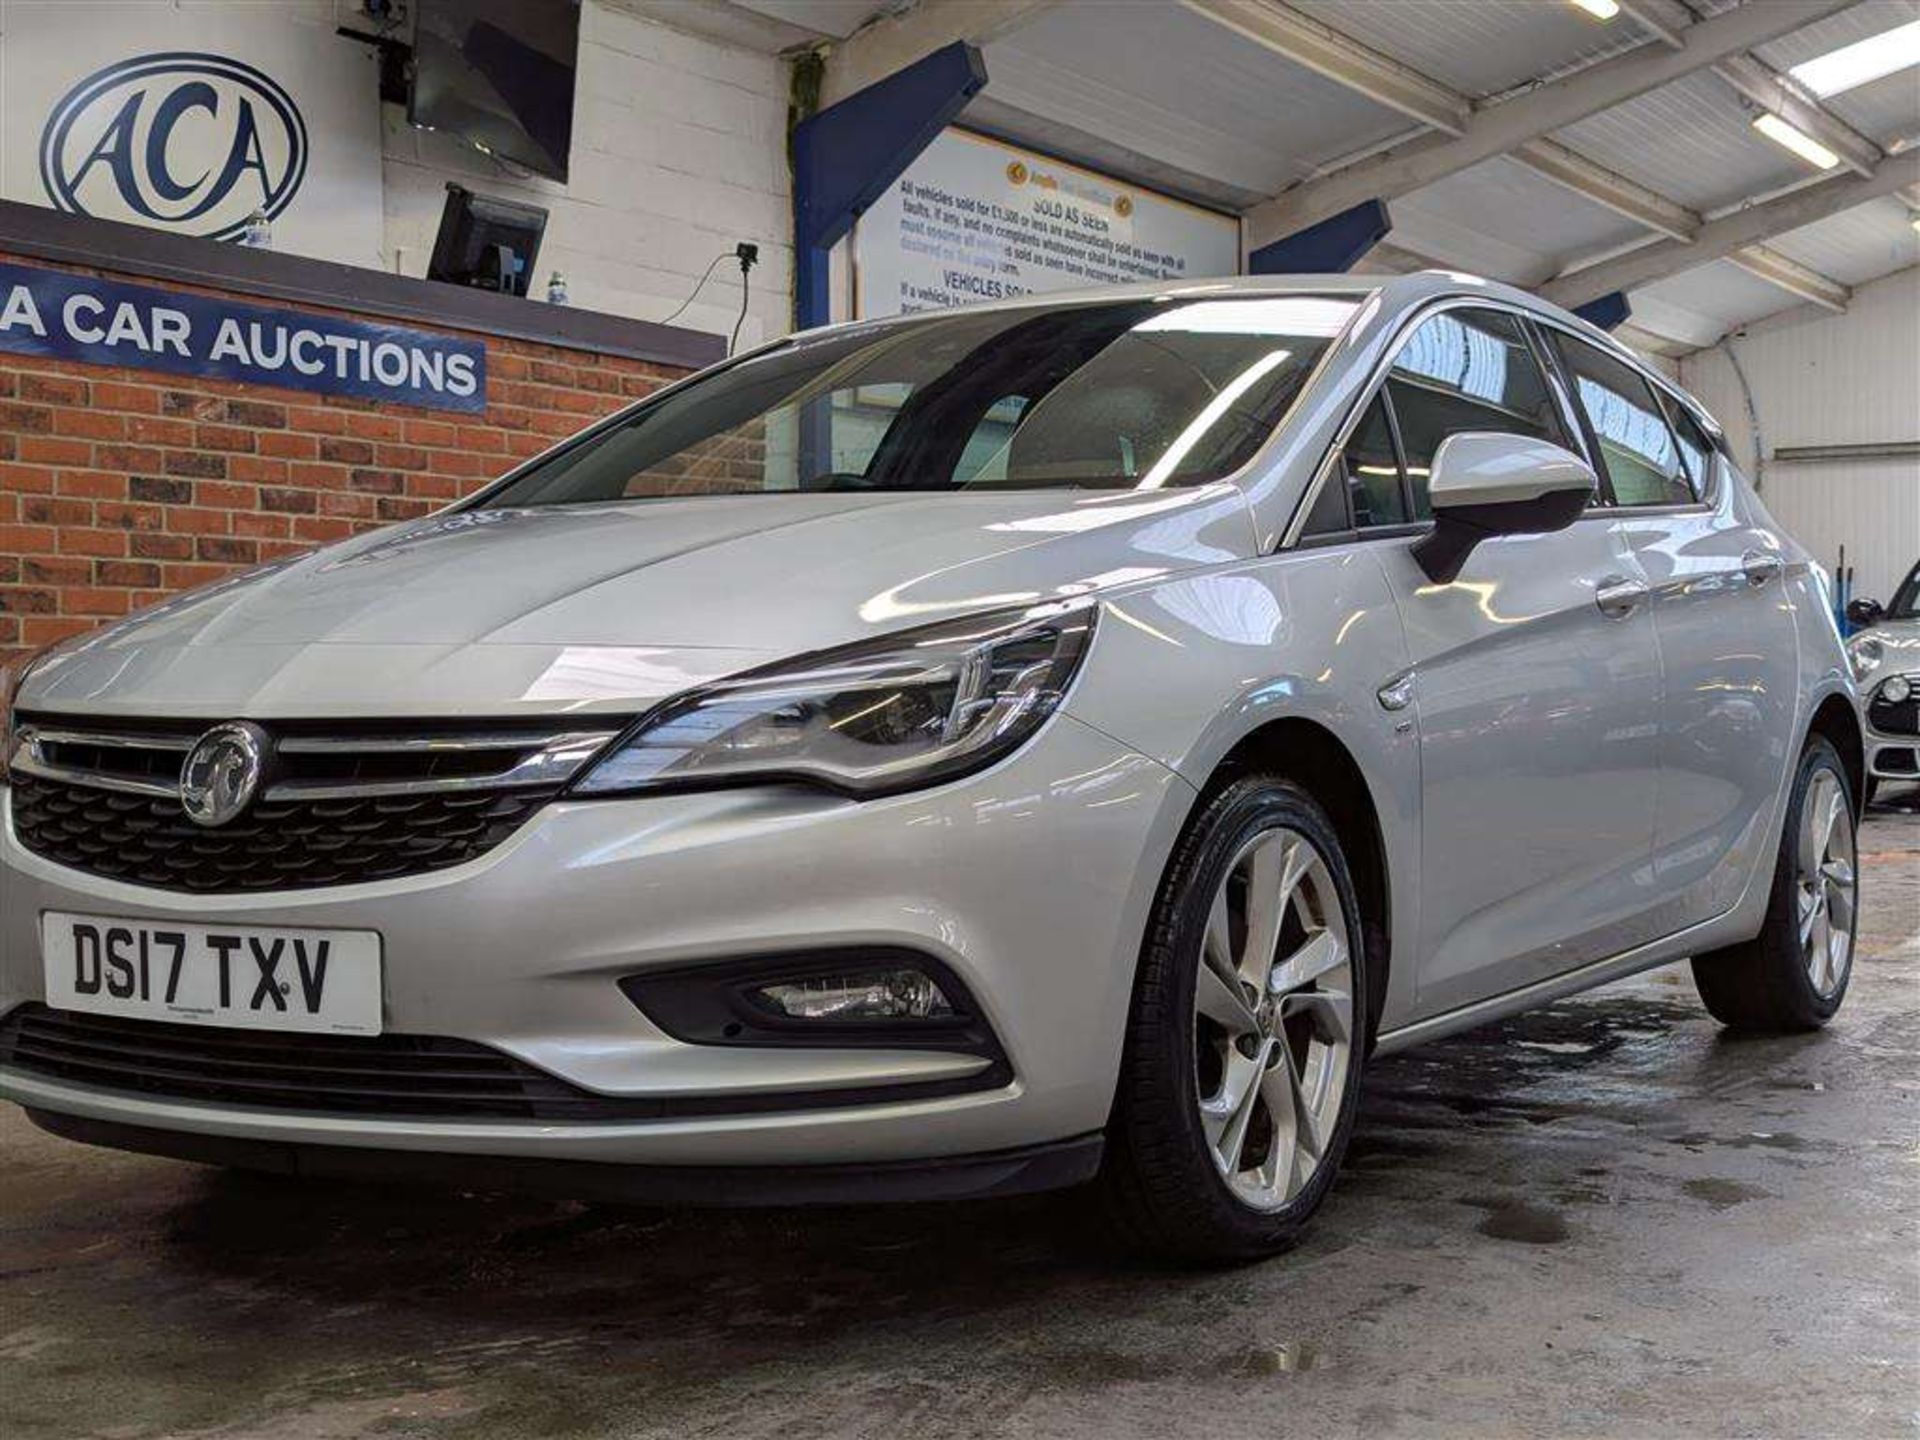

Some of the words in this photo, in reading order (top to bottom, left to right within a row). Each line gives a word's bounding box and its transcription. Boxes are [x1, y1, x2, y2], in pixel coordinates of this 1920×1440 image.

[66, 82, 272, 221] ACA
[901, 180, 913, 194] All
[915, 186, 953, 207] vehicles
[956, 195, 975, 212] sold
[977, 201, 989, 215] for
[1021, 216, 1030, 226] or
[1032, 215, 1047, 234] less
[1050, 224, 1062, 236] are
[1065, 226, 1114, 254] automatically
[1115, 242, 1131, 256] sold
[1133, 248, 1142, 259] as
[1034, 197, 1062, 218] SOLD
[1065, 207, 1079, 224] AS
[963, 217, 980, 231] and
[982, 222, 993, 235] no
[995, 227, 1040, 247] complaints
[1042, 237, 1086, 259] whatsoever
[1088, 248, 1105, 264] shall
[1108, 254, 1116, 268] be
[1014, 249, 1031, 262] sold
[1034, 254, 1043, 265] as
[1045, 254, 1063, 269] seen
[1065, 260, 1083, 275] have
[1085, 264, 1118, 283] incorrect
[918, 287, 950, 305] vehicle
[944, 270, 1001, 299] VEHICLES
[0, 285, 47, 337] A
[62, 293, 191, 358] CAR
[209, 317, 477, 397] AUCTIONS
[73, 923, 186, 1004] DS17
[206, 935, 330, 1013] TXV
